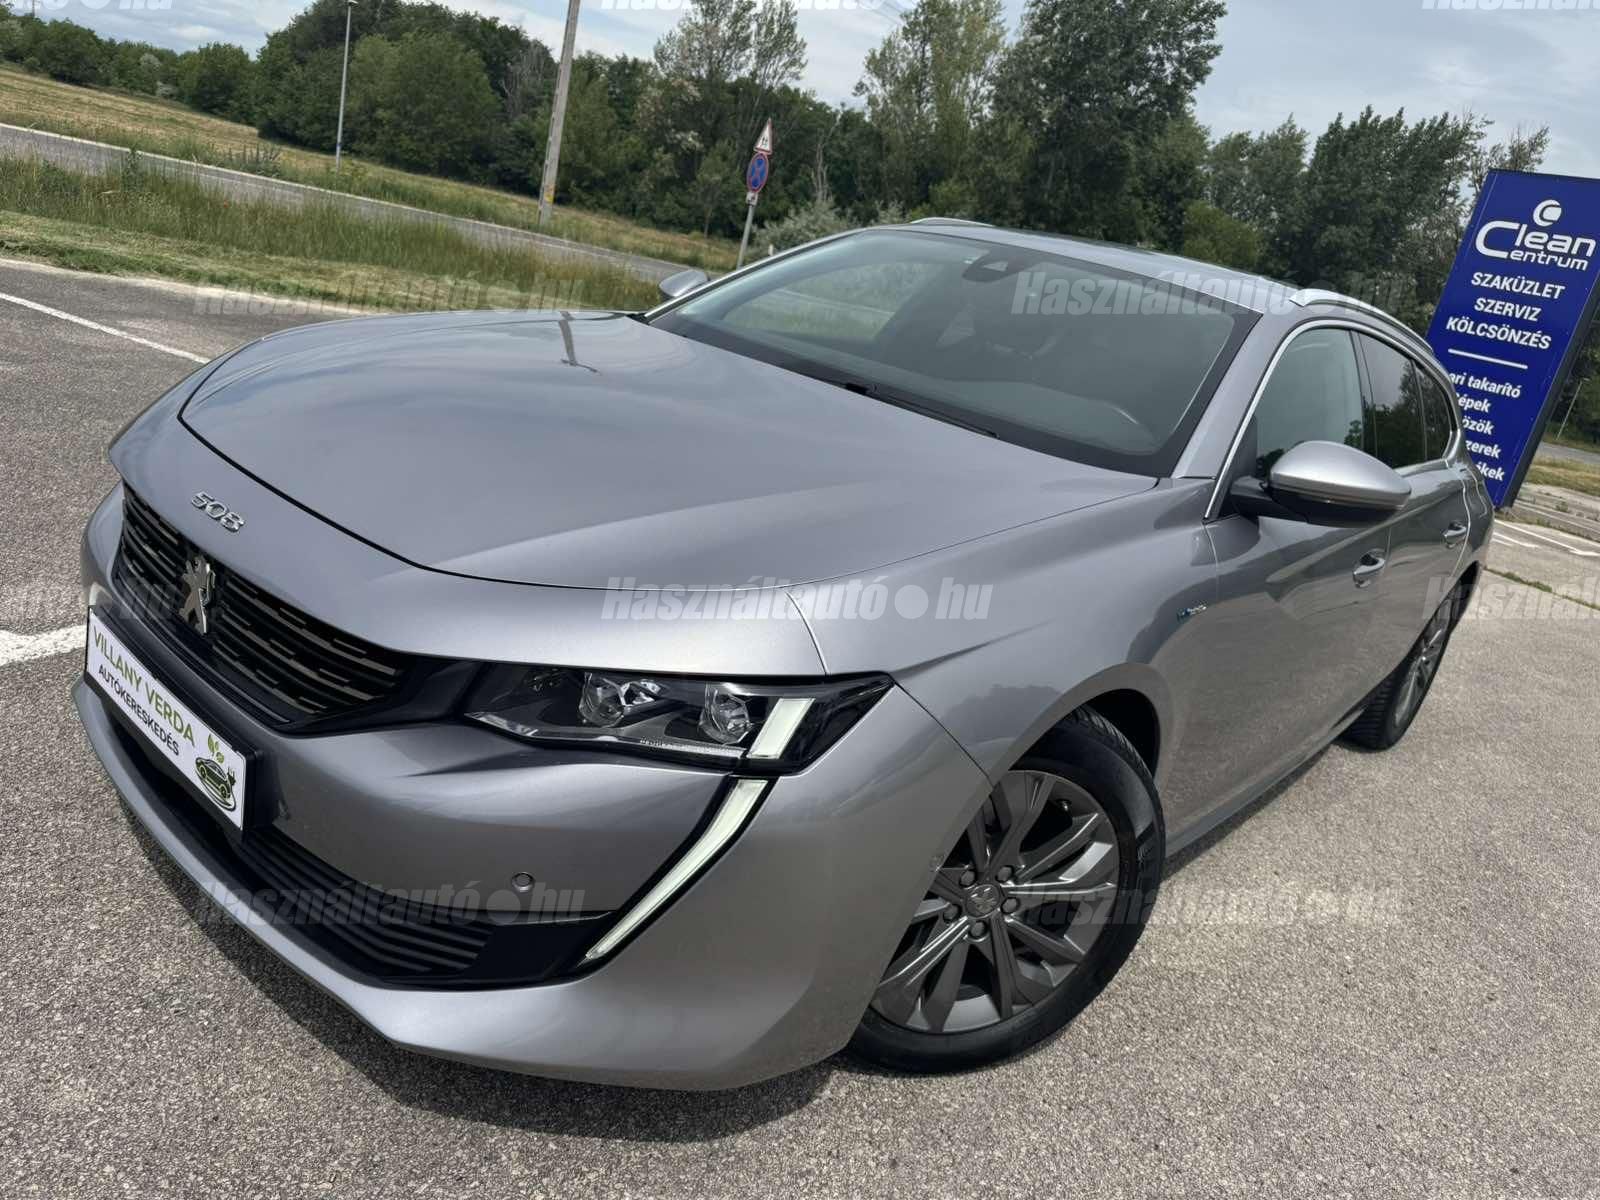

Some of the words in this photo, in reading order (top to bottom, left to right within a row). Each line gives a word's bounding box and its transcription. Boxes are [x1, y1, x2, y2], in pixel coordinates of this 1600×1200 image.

[1475, 220, 1597, 259] Clean
[1471, 272, 1565, 299] SZAKÜZLET
[1474, 297, 1542, 321] SZERVIZ
[1446, 316, 1552, 350] KÖLCSÖNZÉS
[1456, 392, 1491, 413] épek
[1467, 375, 1522, 399] takarító
[191, 490, 245, 533] 508
[93, 625, 142, 692] VILLANY
[145, 682, 196, 748] VERDA
[98, 663, 180, 757] AUTÓKERESKEDÉS
